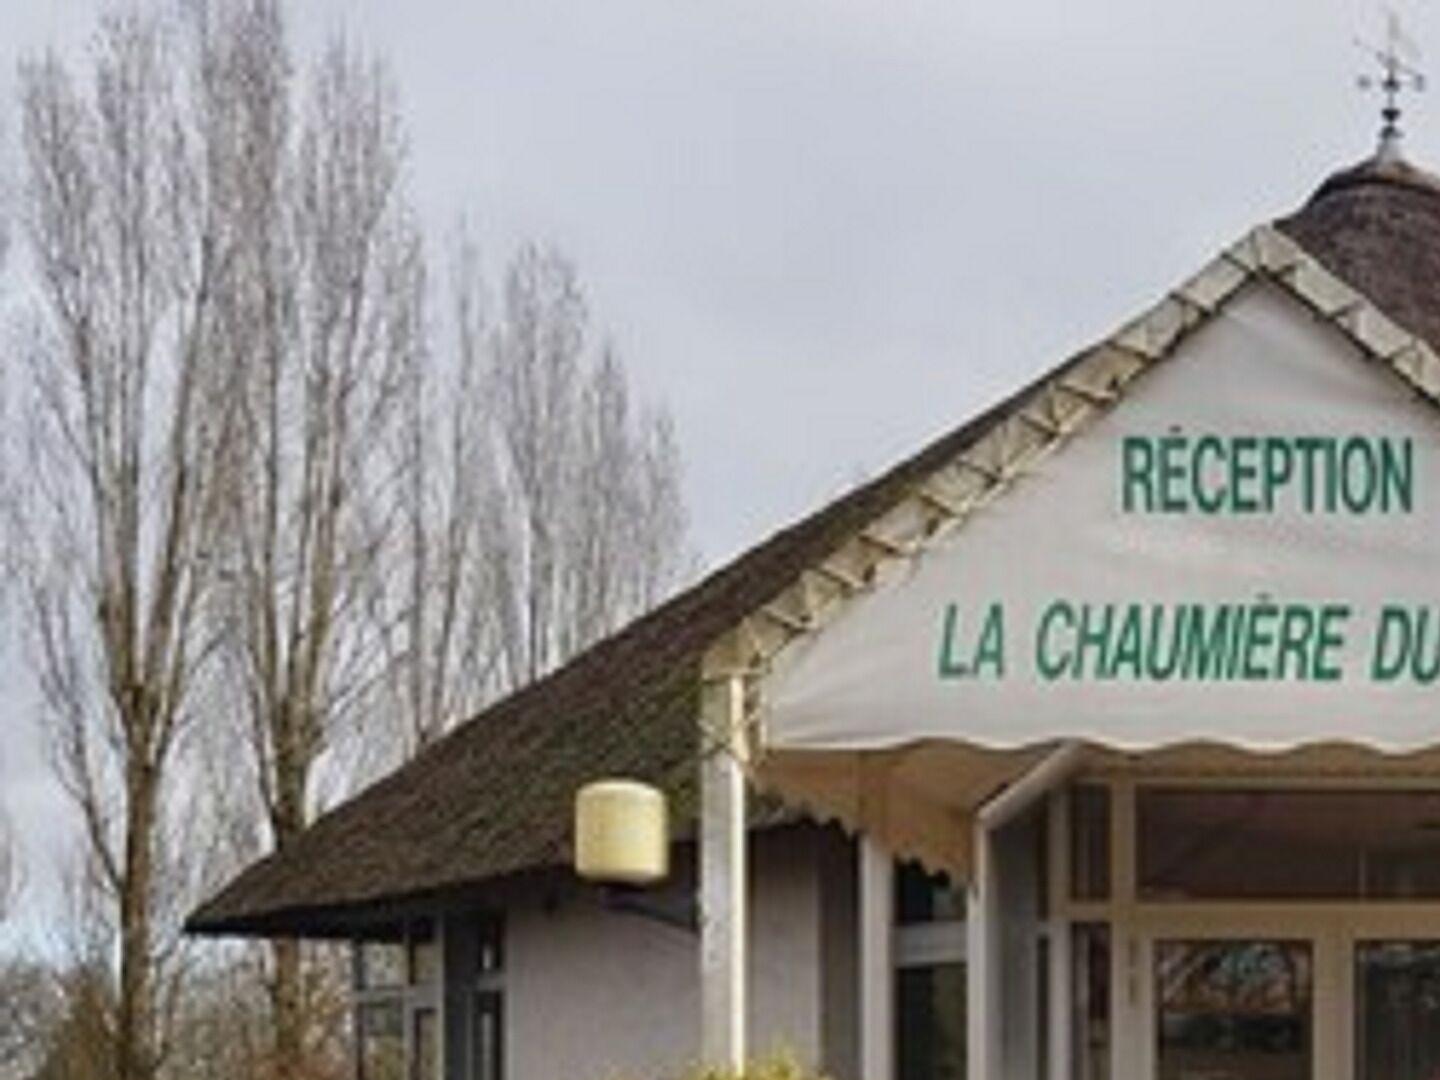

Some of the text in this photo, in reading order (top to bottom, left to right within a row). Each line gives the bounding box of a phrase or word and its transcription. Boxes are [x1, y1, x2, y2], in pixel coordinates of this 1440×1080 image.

[1122, 426, 1413, 513] RÉCEPTION
[938, 603, 1003, 679] LA
[1036, 594, 1348, 680] CHAUMIÈRE
